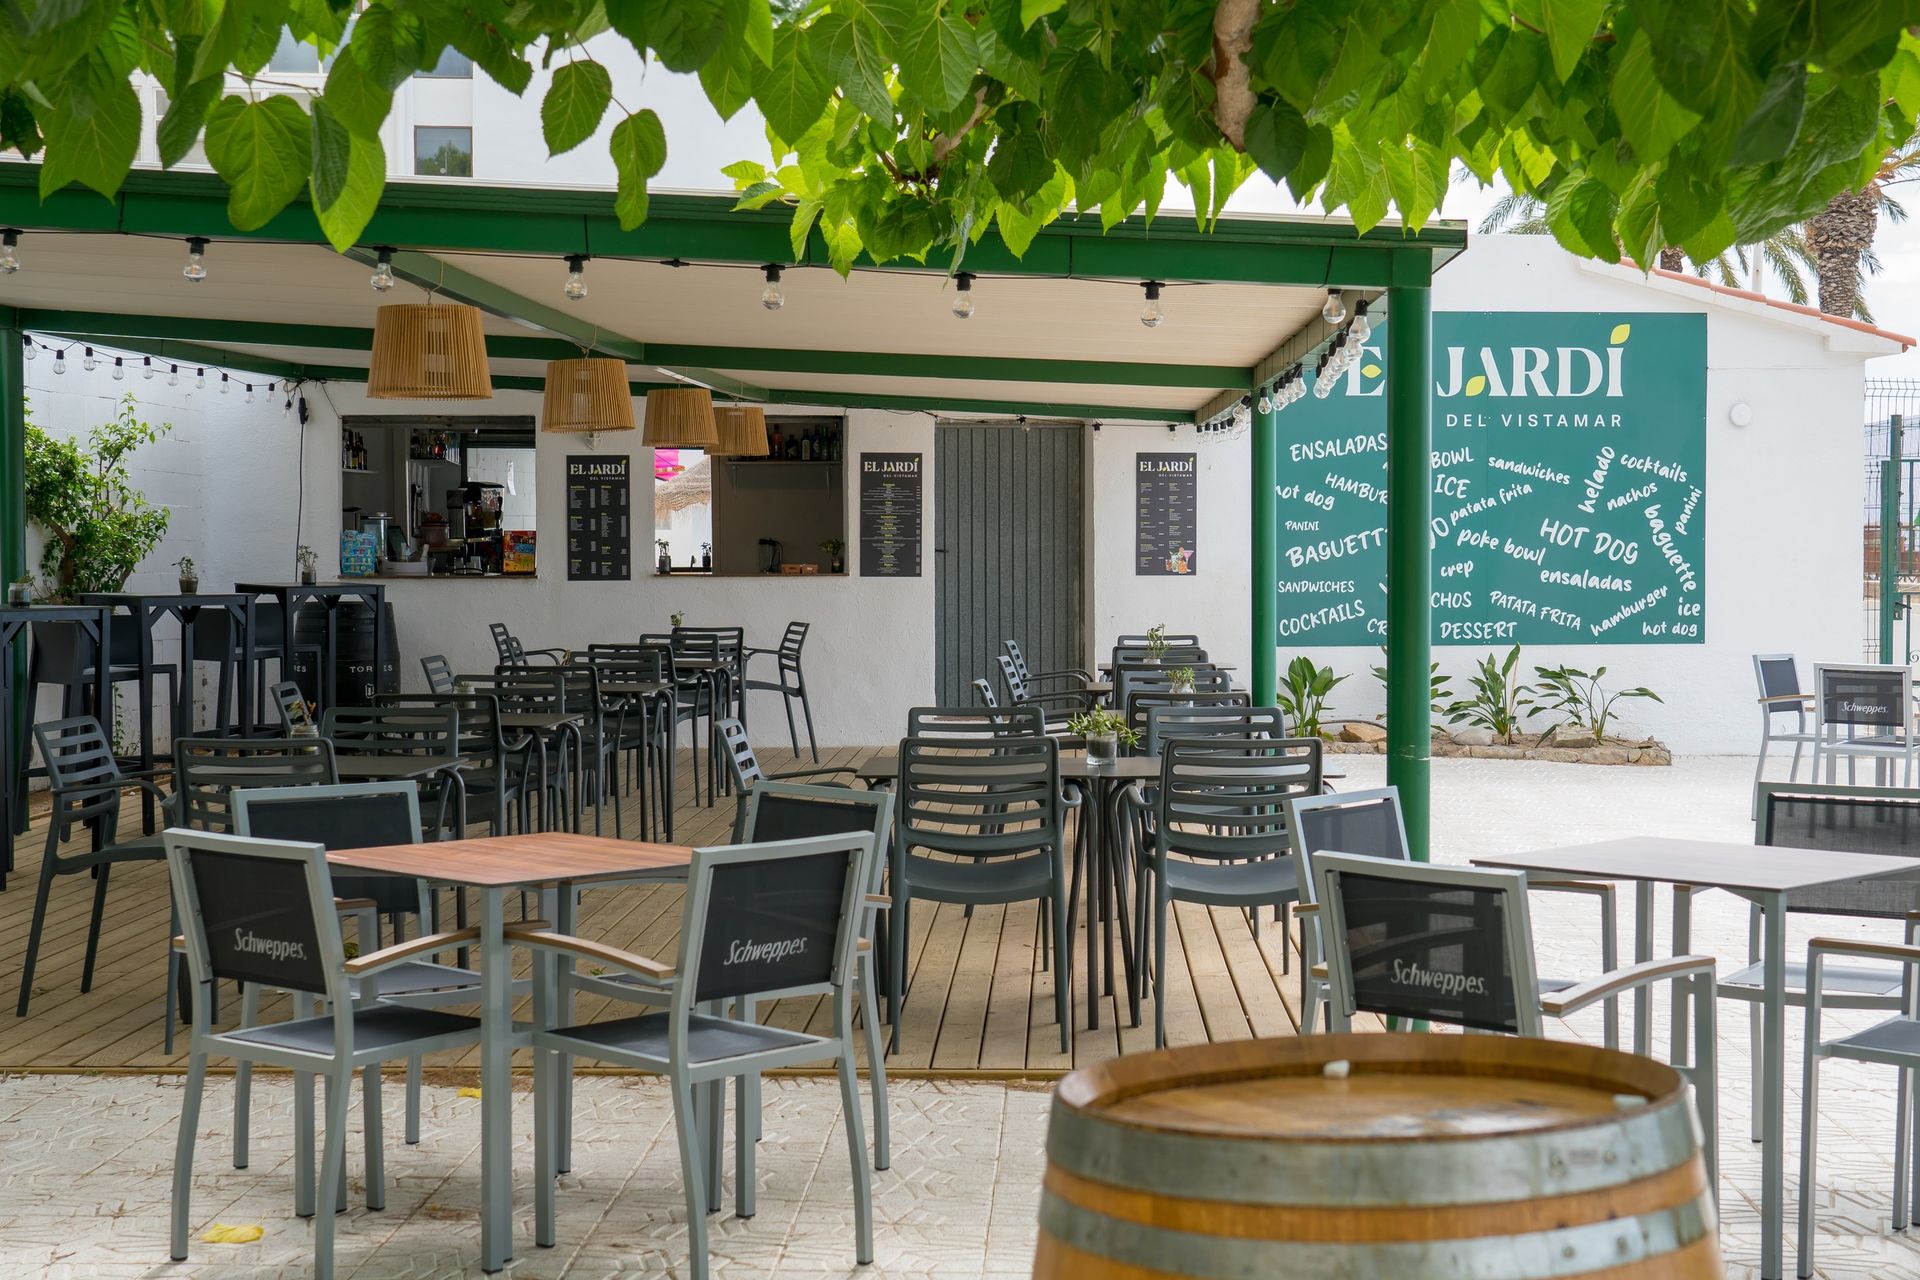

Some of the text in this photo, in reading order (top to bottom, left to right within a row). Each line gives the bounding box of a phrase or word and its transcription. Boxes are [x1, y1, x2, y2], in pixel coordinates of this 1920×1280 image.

[1345, 346, 1386, 396] E
[1446, 414, 1622, 427] DEL VISTAMAR
[1289, 433, 1388, 462] ENSALADAS
[1430, 446, 1475, 469] BOWL
[570, 464, 586, 475] EL
[864, 461, 880, 472] EL
[1140, 461, 1156, 472] EL
[1488, 455, 1571, 485] sandwiches
[1620, 453, 1688, 483] cocktails
[1325, 472, 1388, 505] HAMBUR
[1434, 473, 1471, 499] ICE
[1577, 446, 1616, 514] helado
[1304, 489, 1336, 511] dog
[1450, 484, 1533, 526] patata frita
[1607, 482, 1658, 511] nachos
[1675, 485, 1702, 535] panini
[1284, 520, 1320, 531] PANINI
[1285, 527, 1388, 568] BAGUETT
[1457, 529, 1547, 566] poke bowl
[1540, 518, 1639, 565] HOT DOG
[1644, 504, 1697, 593] baguette
[1440, 560, 1474, 578] crep
[1540, 569, 1633, 592] ensaladas
[1278, 580, 1355, 593] SANDWICHES
[1430, 591, 1472, 609] CHOS
[1490, 590, 1582, 631] PATATA FRITA
[1590, 585, 1668, 637] hamburger
[1677, 596, 1701, 617] ice
[1440, 621, 1518, 640] DESSERT
[1642, 621, 1698, 637] hot dog
[348, 664, 393, 674] TORES
[1841, 701, 1886, 714] Schweppes
